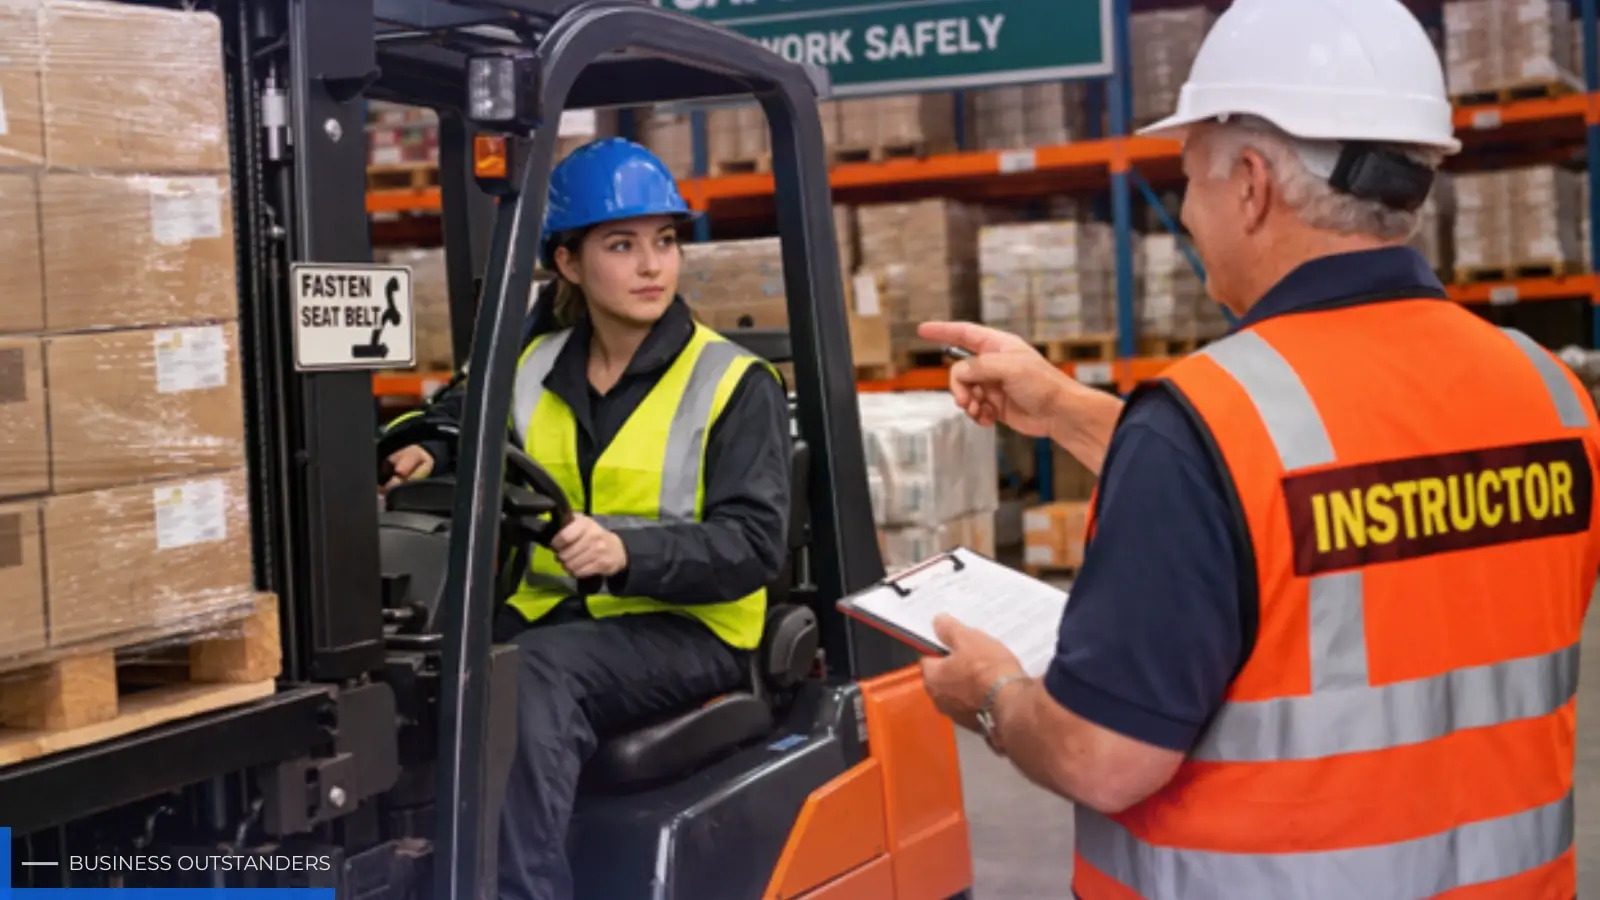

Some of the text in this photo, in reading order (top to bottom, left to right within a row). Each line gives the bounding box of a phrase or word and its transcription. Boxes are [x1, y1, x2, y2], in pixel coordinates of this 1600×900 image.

[864, 14, 1004, 61] SAFELY
[302, 274, 371, 297] FASTEN
[302, 305, 380, 327] SEAT BELT
[1311, 461, 1575, 553] INSTRUCTOR
